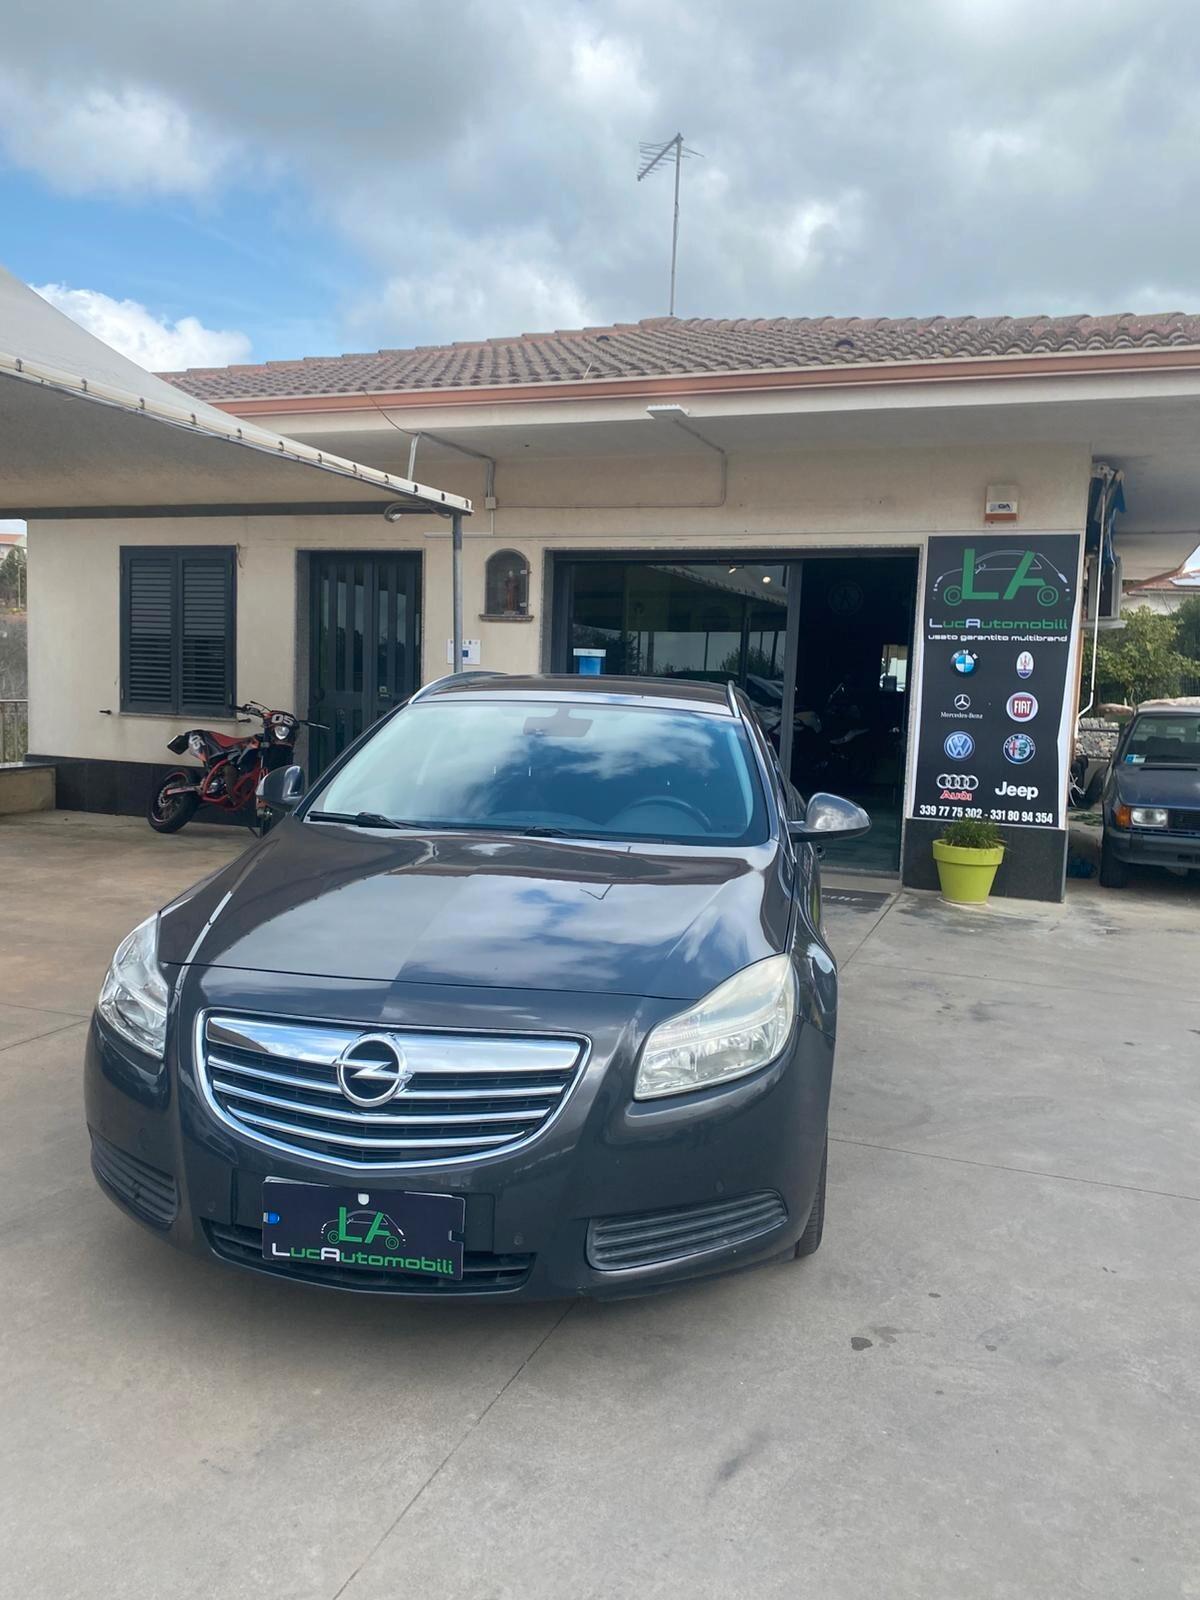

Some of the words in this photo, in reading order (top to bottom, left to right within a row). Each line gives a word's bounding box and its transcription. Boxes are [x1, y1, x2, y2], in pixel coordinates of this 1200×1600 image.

[929, 618, 1068, 630] LucAutomobili
[960, 634, 1009, 642] garantito
[1011, 634, 1068, 642] multibrand
[1013, 700, 1032, 714] FIAT
[271, 713, 294, 726] 05
[940, 790, 973, 801] Audi
[994, 781, 1039, 800] Jeep
[919, 804, 937, 816] 339
[938, 805, 950, 817] 77
[951, 806, 963, 818] 75
[964, 807, 983, 819] 302
[990, 809, 1006, 821] 331
[1007, 811, 1019, 822] 80
[1021, 811, 1034, 822] 94
[1035, 812, 1053, 824] 354
[271, 1243, 455, 1275] LucAutomobili
